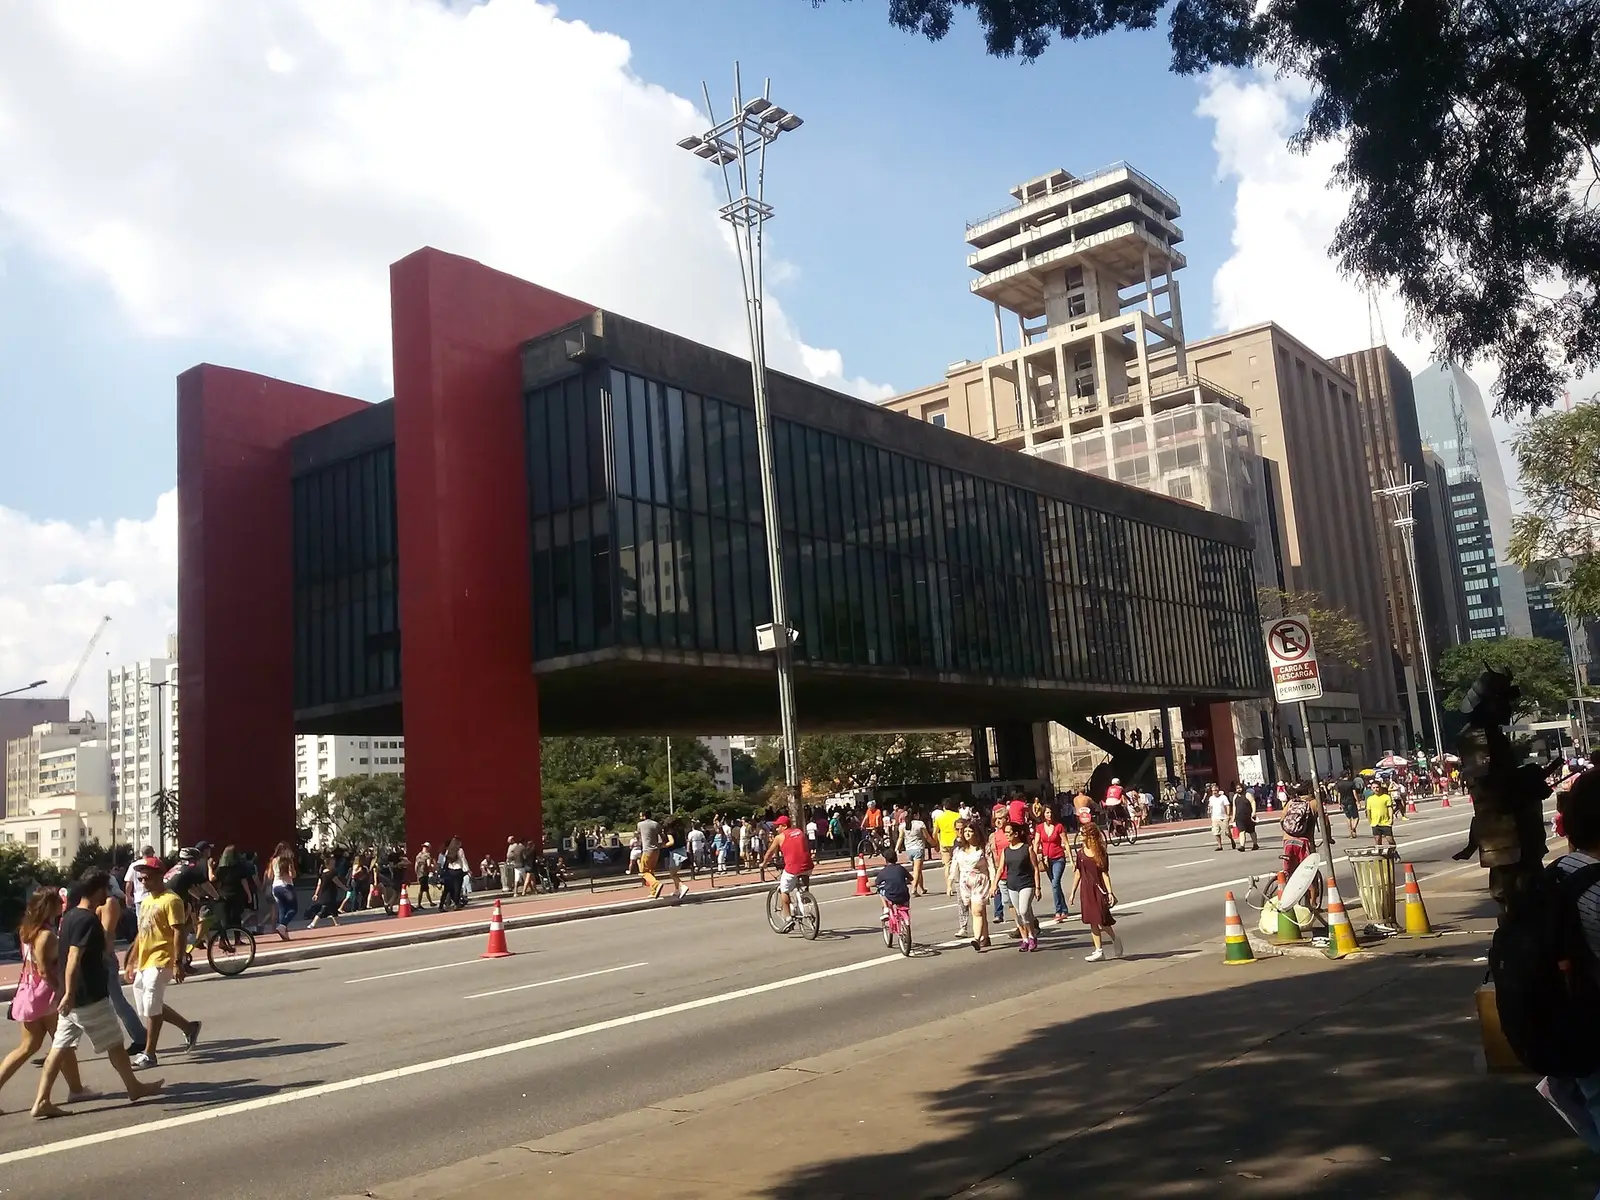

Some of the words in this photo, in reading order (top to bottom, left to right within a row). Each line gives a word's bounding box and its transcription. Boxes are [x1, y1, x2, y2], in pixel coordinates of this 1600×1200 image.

[1279, 664, 1303, 673] CARGA
[1277, 670, 1314, 680] DESCARGA
[1280, 683, 1316, 693] PERMITIDA
